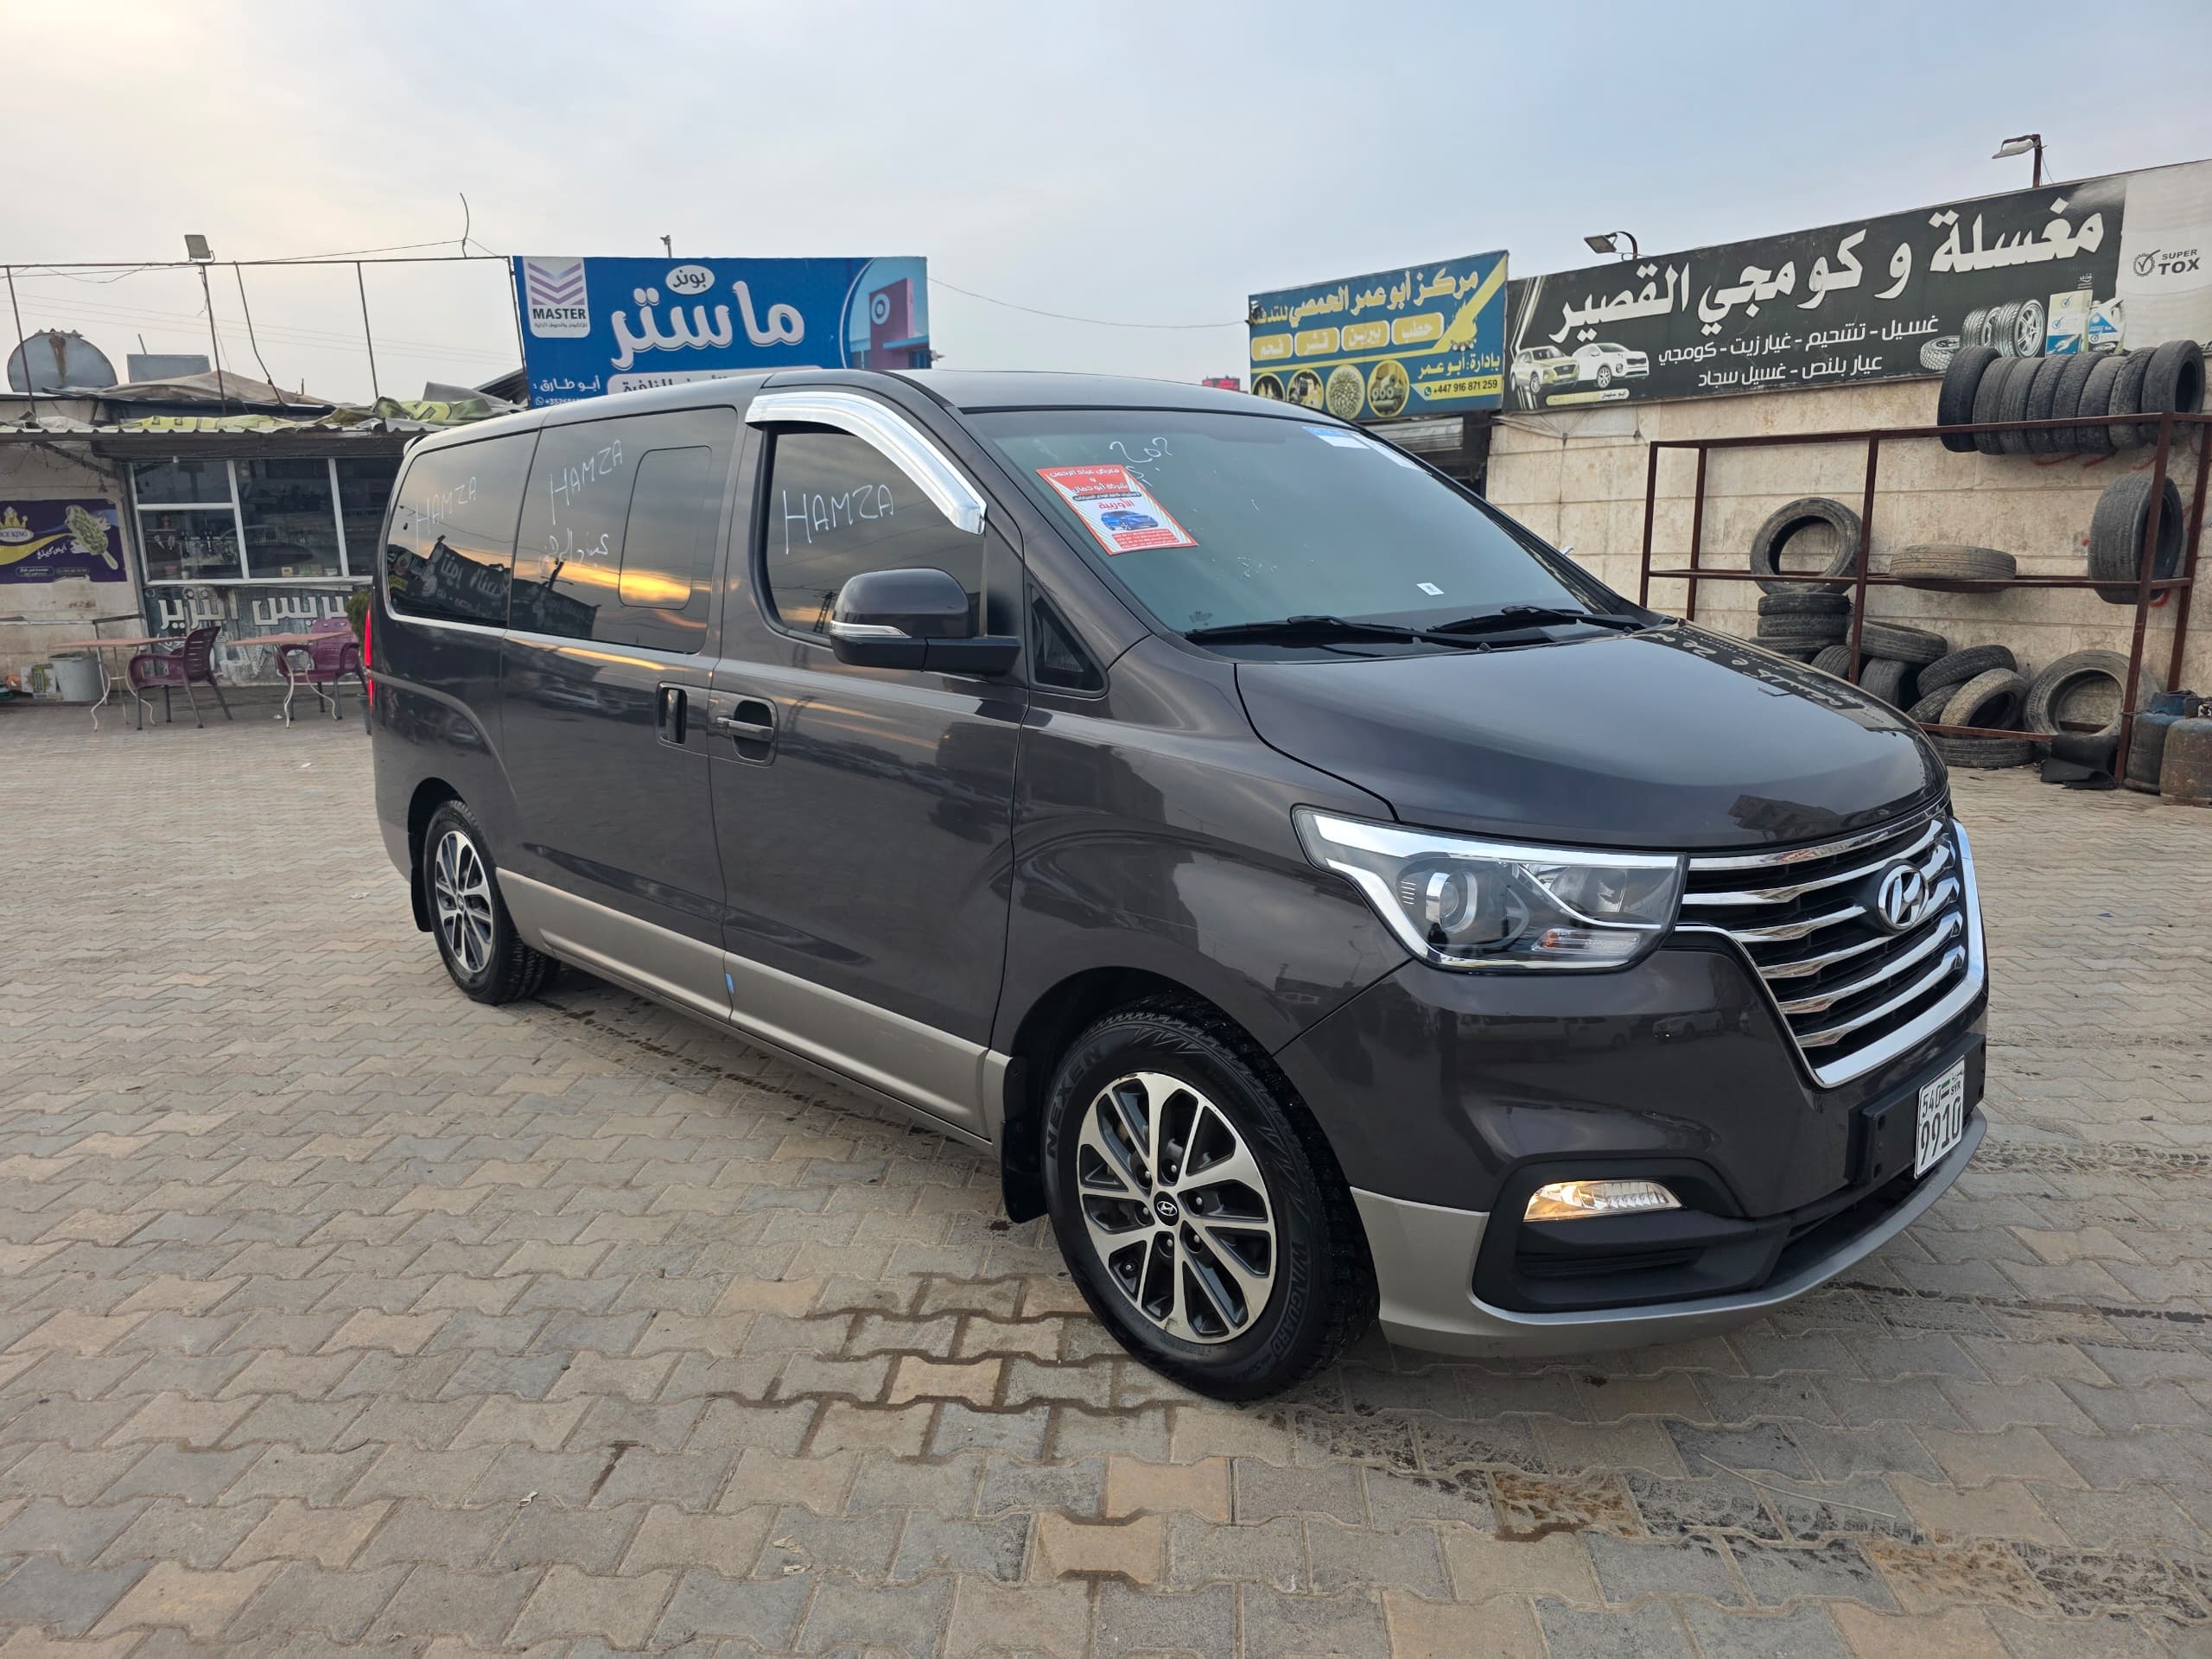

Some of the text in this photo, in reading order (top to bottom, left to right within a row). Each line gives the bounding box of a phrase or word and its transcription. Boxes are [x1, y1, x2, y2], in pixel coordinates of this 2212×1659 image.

[1929, 195, 2104, 274] مغسلة
[2158, 257, 2201, 276] TOX
[2161, 249, 2198, 261] SUPER
[672, 269, 706, 289] بوند
[1874, 241, 1913, 300] و
[1387, 270, 1411, 310] أبو
[1413, 267, 1479, 306] مركز
[1289, 285, 1349, 327] الحمصي
[1351, 285, 1386, 316] عمر
[1549, 261, 1690, 344] القصير
[532, 308, 586, 320] MASTER
[610, 280, 805, 371] ماستر
[1401, 321, 1433, 343] حطب
[1805, 322, 1866, 352] تشحيم
[1882, 315, 1940, 340] غسيل
[1658, 341, 1717, 366] كومجي
[1730, 337, 1760, 356] زيت
[1763, 332, 1792, 355] غيار
[1417, 361, 1445, 380] عمر
[1446, 350, 1465, 377] أبو
[1741, 361, 1787, 385] غسيل
[1802, 356, 1847, 380] بلنص
[1849, 354, 1883, 376] عيار
[577, 374, 601, 392] أبو
[1433, 379, 1498, 394] +447 916 871 259
[1698, 366, 1739, 387] سجاد
[550, 438, 623, 526] HAMZA
[1049, 468, 1077, 478] الرحمن
[416, 476, 477, 552] HAMZA
[783, 484, 894, 555] HAMZA
[1950, 1080, 1961, 1096] SYR
[1922, 1084, 1942, 1118] 540
[1920, 1096, 1961, 1166] 9910
